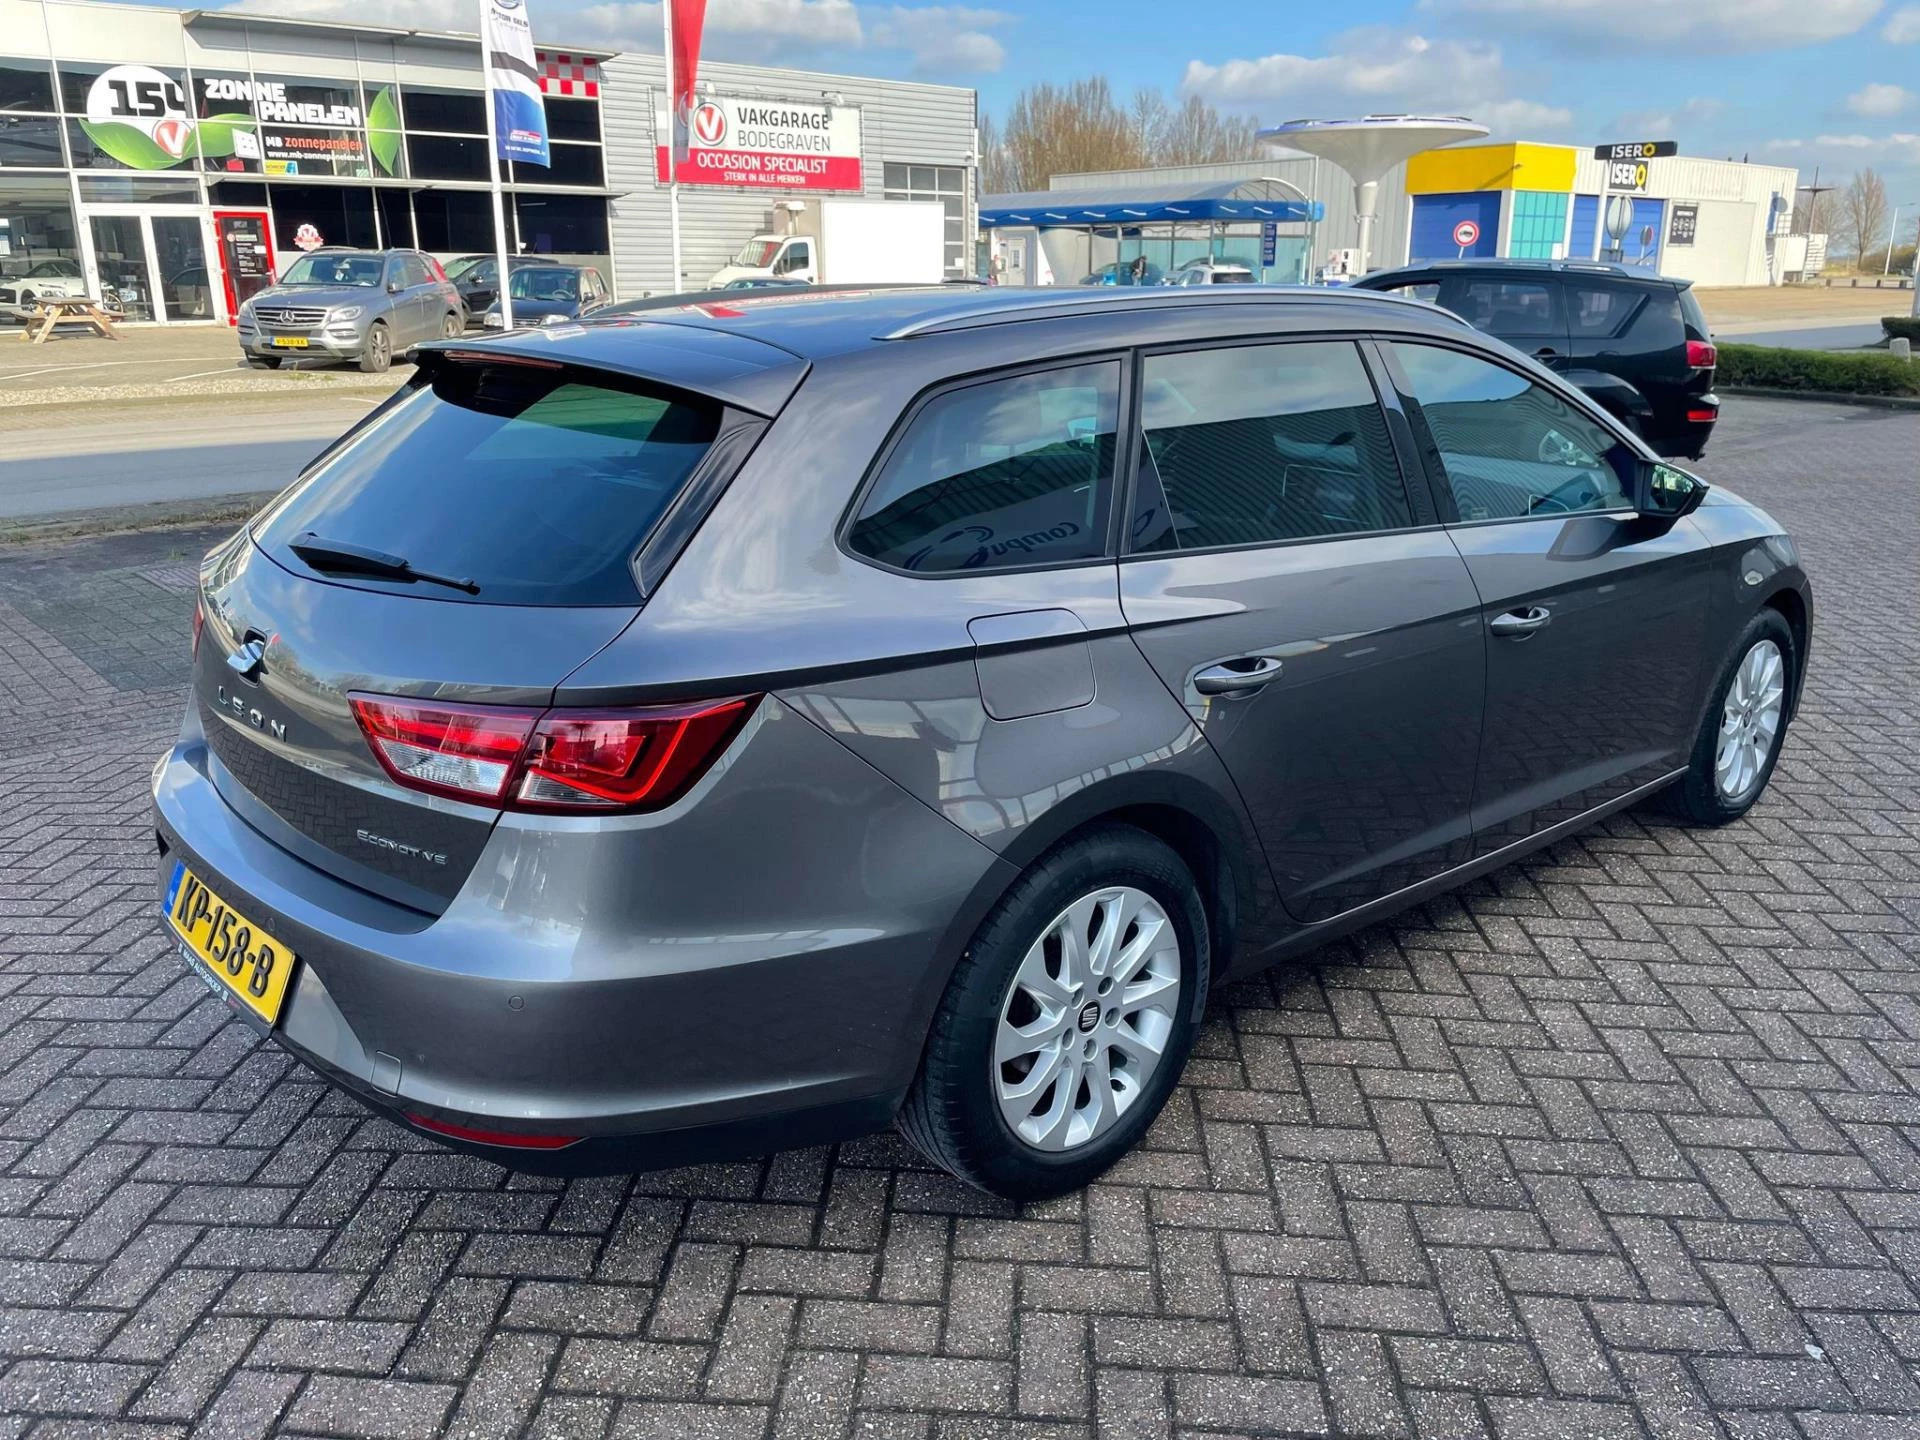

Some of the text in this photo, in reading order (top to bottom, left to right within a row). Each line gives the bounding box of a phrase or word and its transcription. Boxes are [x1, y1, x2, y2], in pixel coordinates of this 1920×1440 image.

[204, 78, 287, 102] ZONNE
[259, 101, 361, 126] PANELEN
[737, 106, 829, 130] VAKGARAGE
[265, 136, 363, 151] MB zonnepanelen
[738, 130, 831, 151] BODEGRAVEN
[1611, 143, 1656, 158] ISERO
[697, 152, 828, 174] OCCASION SPECIALIST
[1611, 163, 1646, 187] ISERO
[724, 171, 805, 185] STERK IN ALLE MERKEN
[219, 685, 287, 742] LEON
[177, 875, 275, 998] KP-158-B
